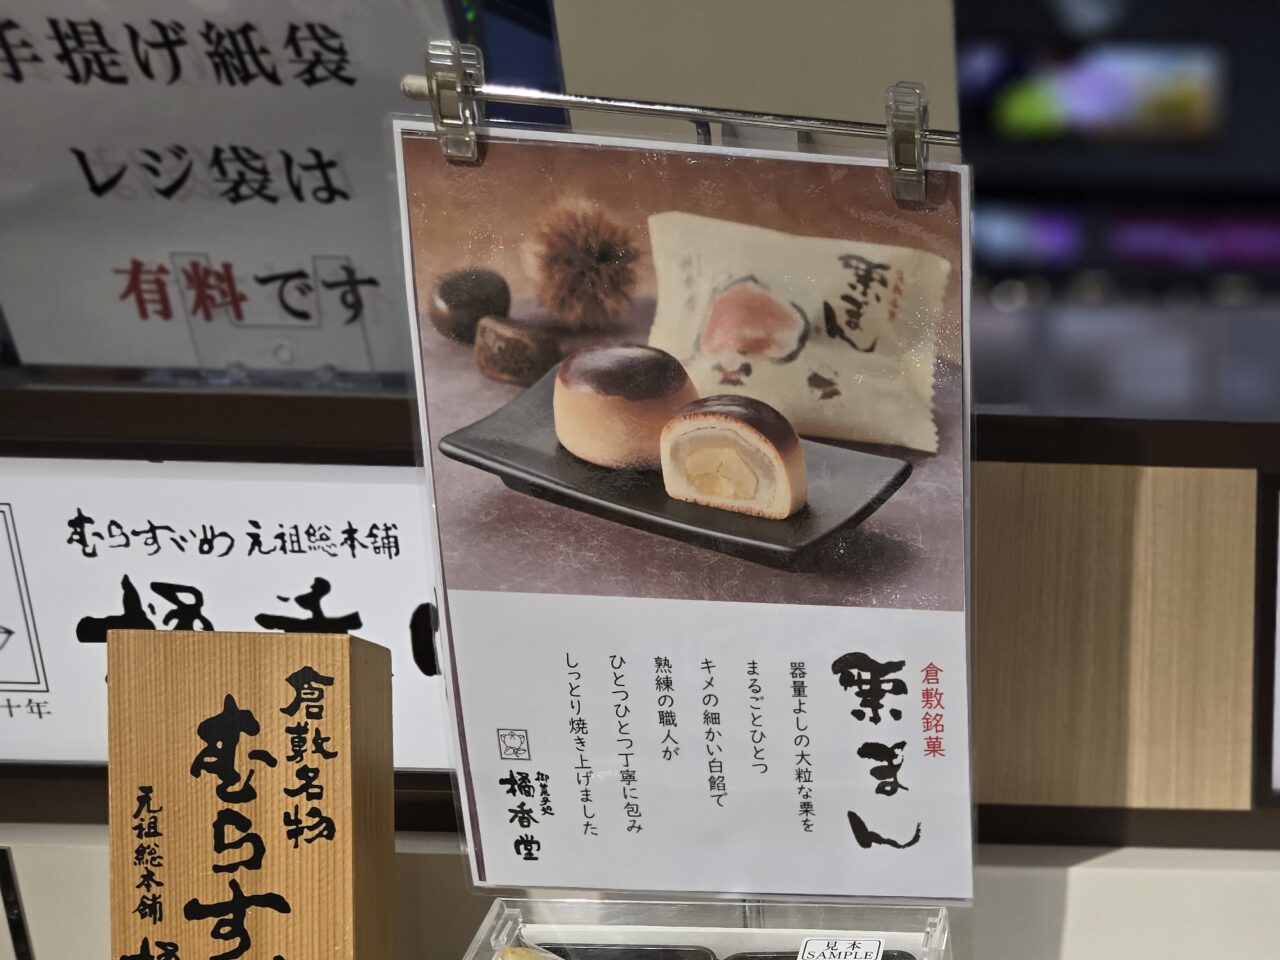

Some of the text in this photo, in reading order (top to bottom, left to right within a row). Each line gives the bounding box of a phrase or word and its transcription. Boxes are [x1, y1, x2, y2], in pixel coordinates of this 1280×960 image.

[0, 15, 358, 90] 手提げ紙袋
[69, 143, 351, 205] レジ袋は
[112, 257, 380, 325] 有料です
[246, 520, 399, 559] 元祖総本舗
[280, 666, 338, 848] 倉敷名物
[567, 653, 598, 835] しっとり焼き上げました
[609, 655, 643, 833] ひとつひとつ丁寧に包み
[654, 656, 679, 760] 熟練の職人が
[701, 658, 727, 807] キメの細かい白餡で
[747, 660, 768, 773] まるごとひとつ
[790, 662, 815, 832] 器量よしの大粒な栗を
[831, 651, 922, 850] 栗まん
[920, 661, 946, 758] 倉敷銘菓
[132, 786, 164, 925] 元祖総本舗
[498, 769, 541, 861] 橘香堂
[806, 951, 874, 960] SAMPLE
[825, 941, 861, 951] 見本
